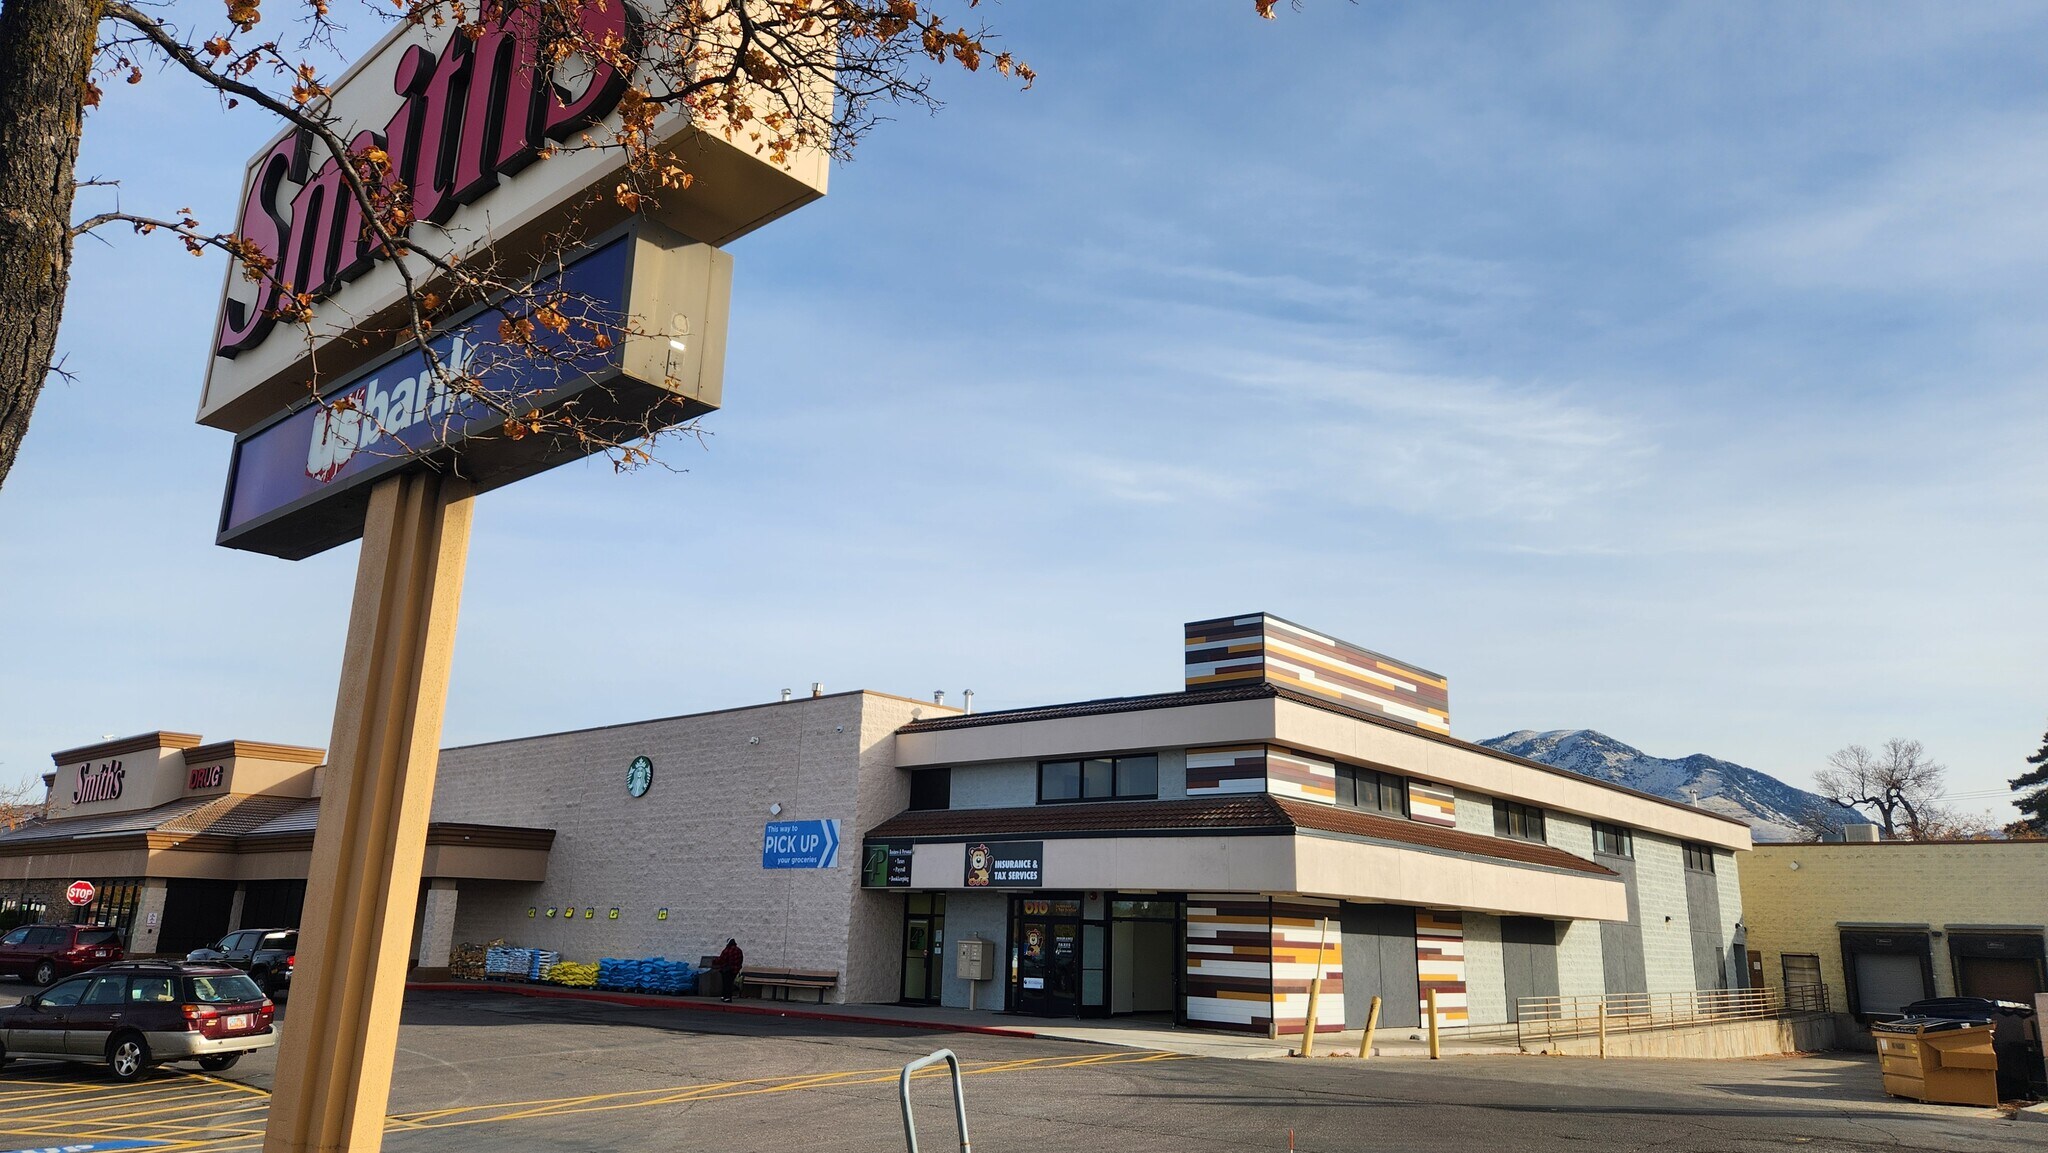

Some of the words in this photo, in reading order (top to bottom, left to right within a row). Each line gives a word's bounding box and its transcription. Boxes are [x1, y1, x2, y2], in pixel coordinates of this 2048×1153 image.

[72, 760, 125, 804] Smith's
[189, 765, 223, 789] DRUG
[766, 836, 796, 853] PICK
[800, 834, 818, 852] UP
[792, 856, 817, 864] groceries
[994, 860, 1031, 868] INSURANCE
[1032, 860, 1038, 868] &
[68, 888, 92, 900] STOP
